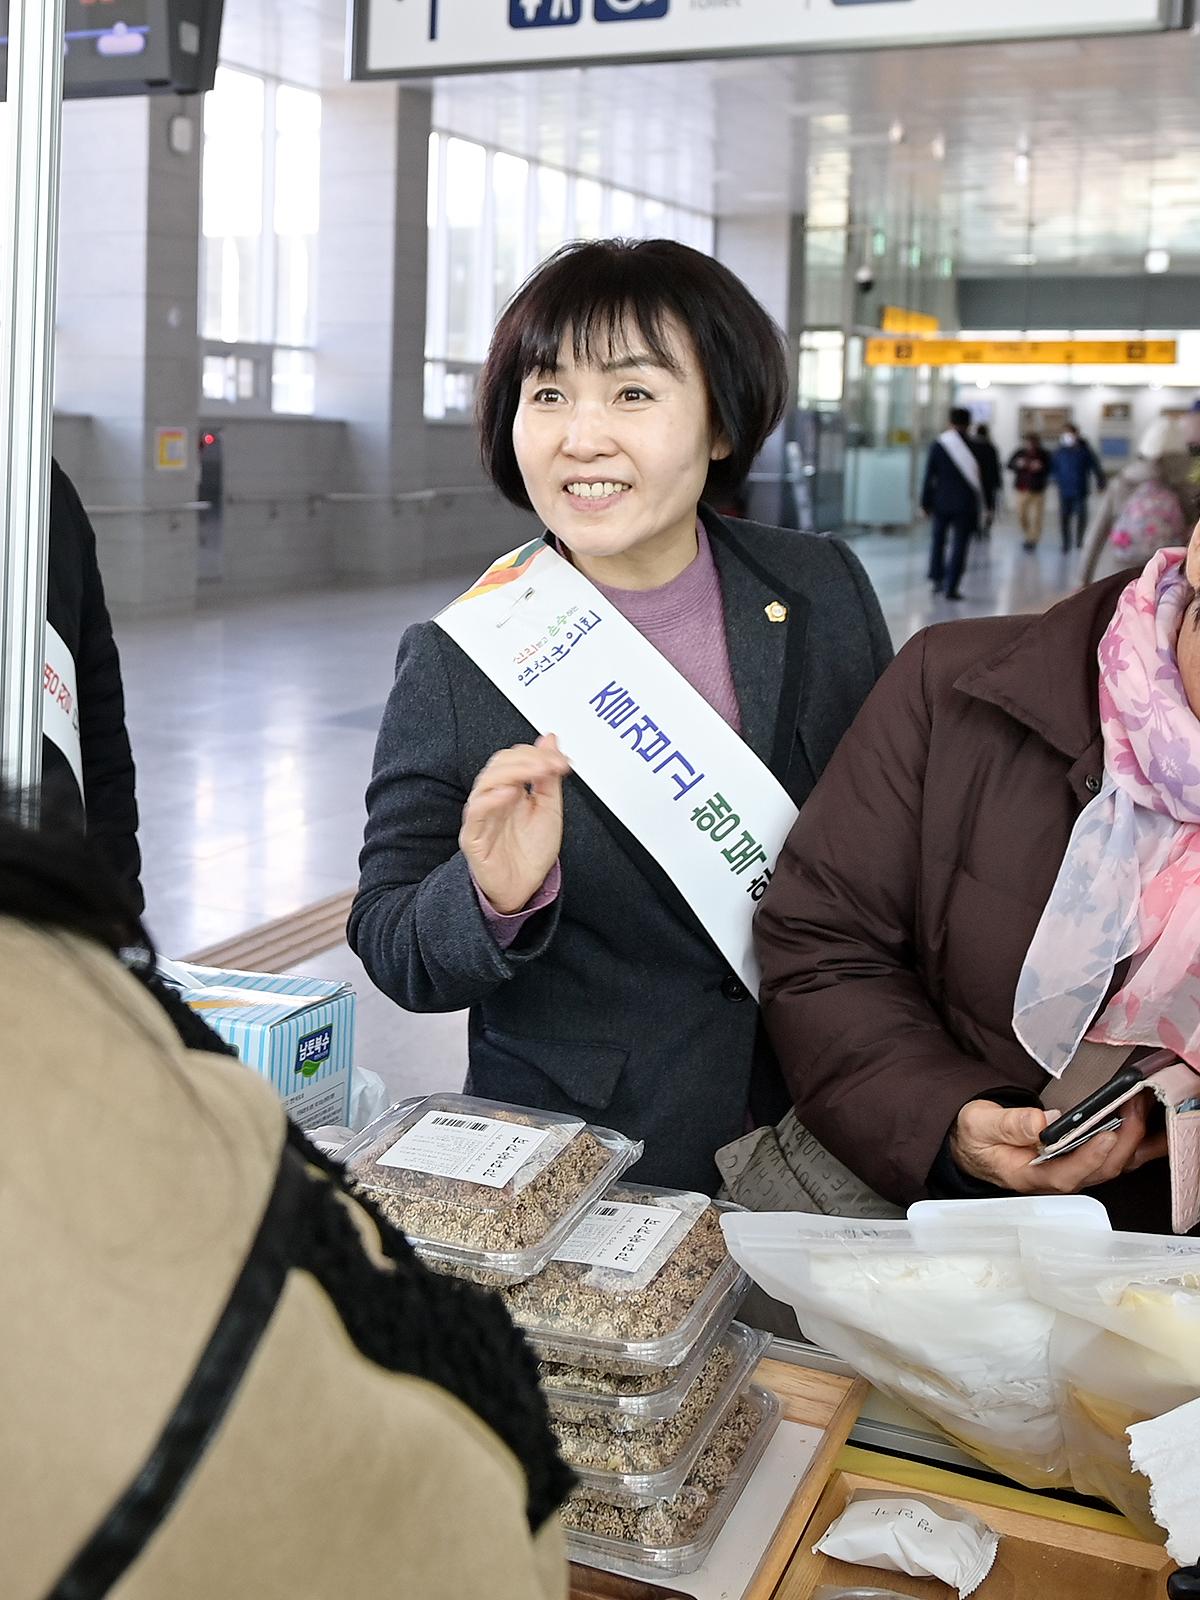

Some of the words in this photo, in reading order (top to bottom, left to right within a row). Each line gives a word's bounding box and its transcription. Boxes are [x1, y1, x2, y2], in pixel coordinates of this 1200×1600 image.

[517, 609, 602, 687] 연천군의회
[588, 680, 705, 801] 즐겁고
[298, 1032, 330, 1061] 남토북수
